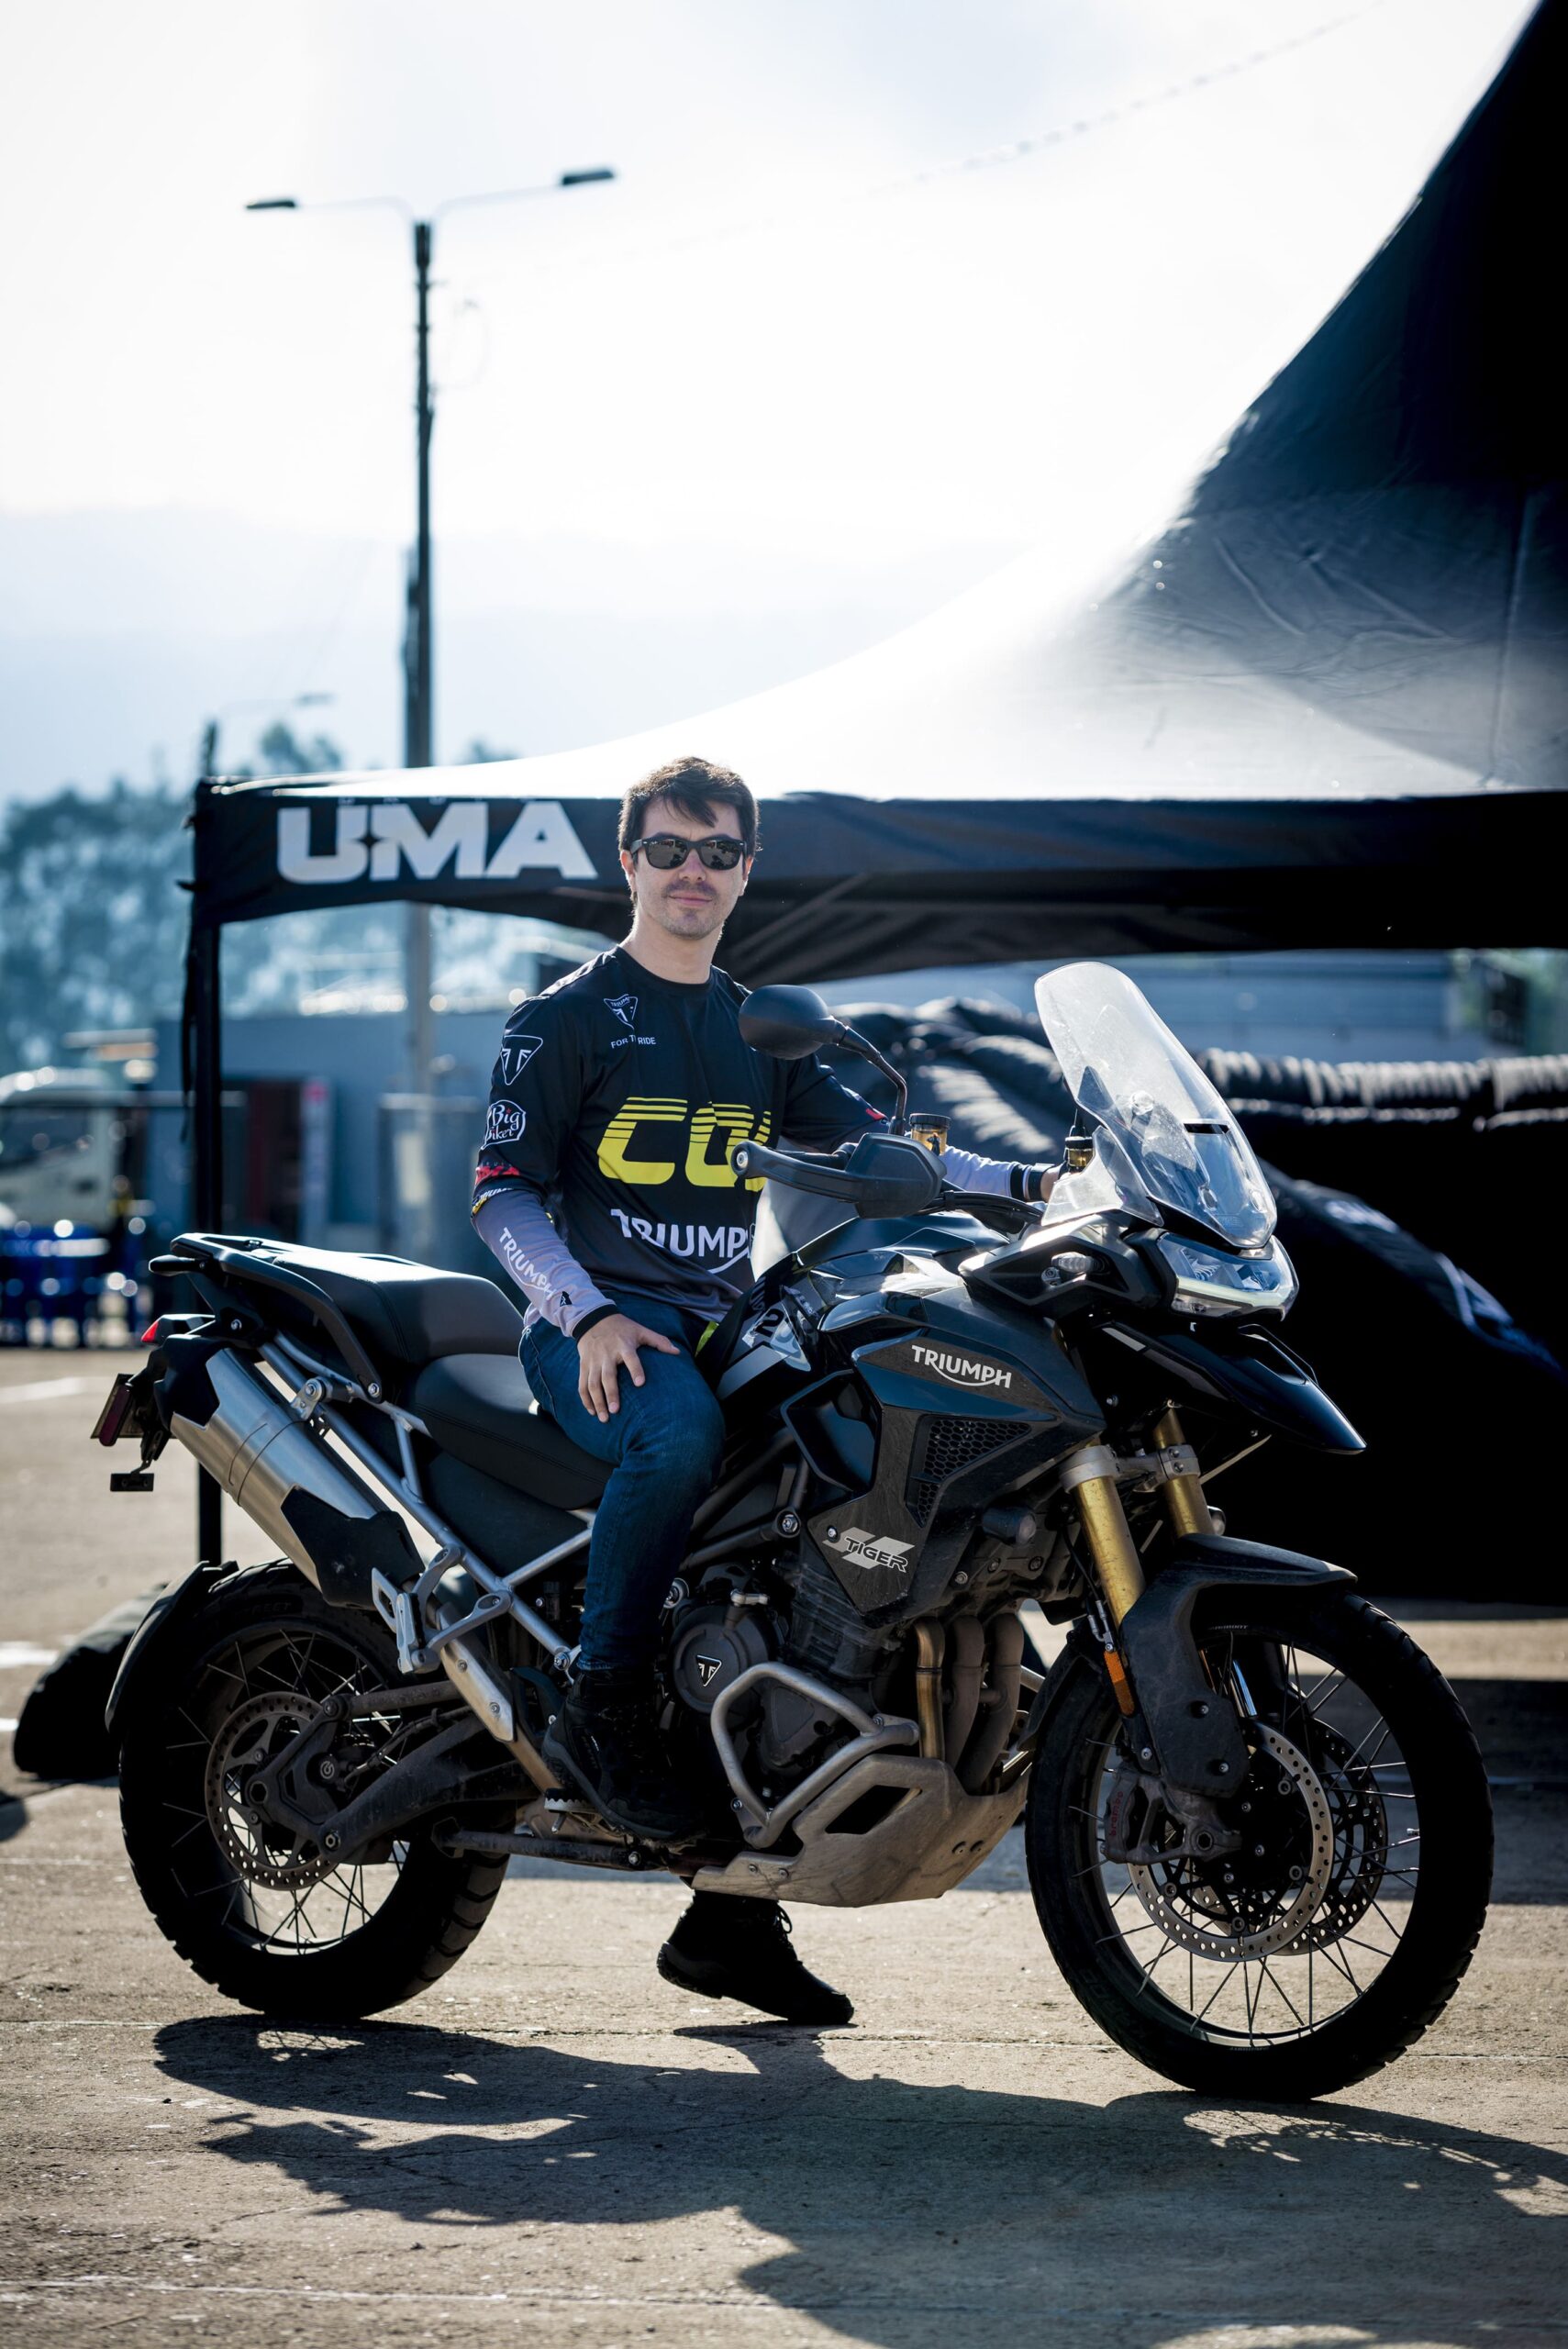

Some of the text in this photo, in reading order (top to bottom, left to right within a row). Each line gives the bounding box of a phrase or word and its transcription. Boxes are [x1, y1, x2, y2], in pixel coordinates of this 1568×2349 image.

[277, 801, 598, 885] UMA
[610, 1037, 628, 1049] FOR
[637, 1037, 656, 1045] RIDE
[492, 1104, 521, 1131] Big
[597, 1097, 771, 1192] CO
[499, 1227, 557, 1301] TRIUMPH
[611, 1208, 751, 1275] TRIUMP
[911, 1344, 1012, 1388] TRIUMPH
[845, 1536, 908, 1573] TIGER
